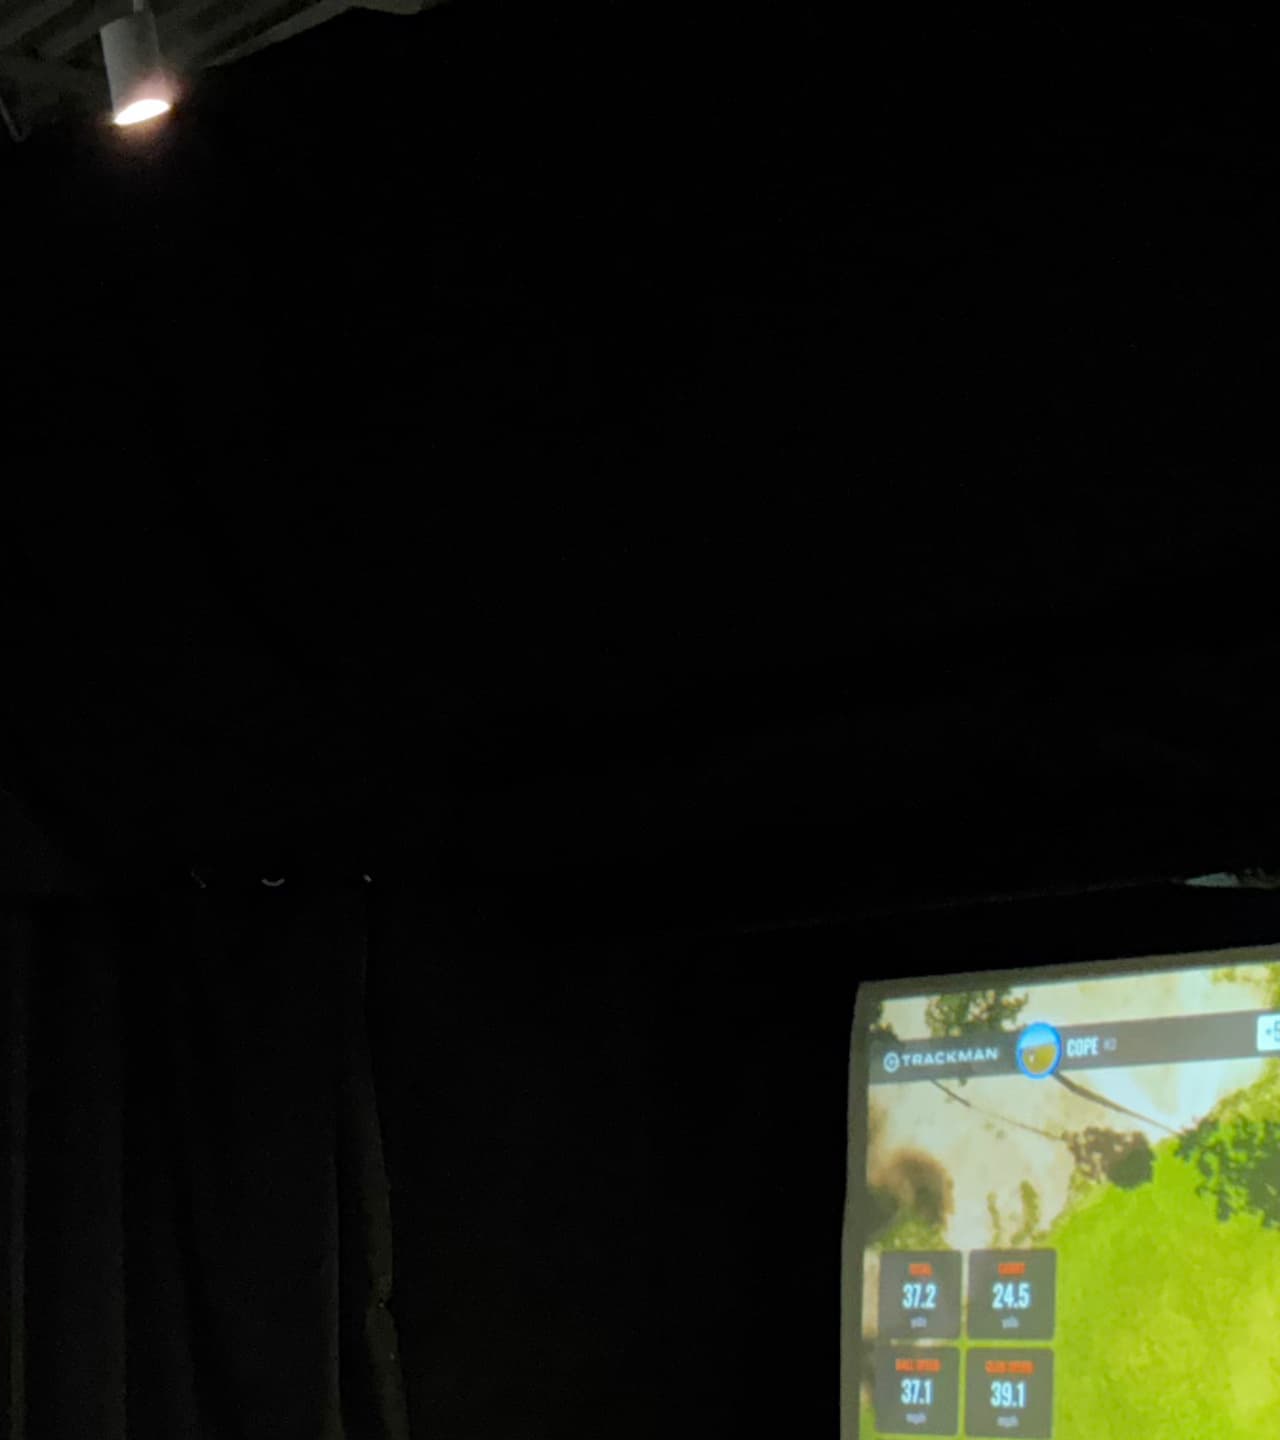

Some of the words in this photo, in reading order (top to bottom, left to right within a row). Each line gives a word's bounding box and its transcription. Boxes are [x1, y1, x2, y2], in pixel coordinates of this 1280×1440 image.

[901, 1047, 1000, 1067] TRACKMAN
[1066, 1036, 1100, 1057] COPE
[902, 1282, 938, 1309] 37.2
[992, 1281, 1031, 1309] 24.5
[900, 1378, 933, 1405] 37.1
[990, 1379, 1027, 1408] 39.1
